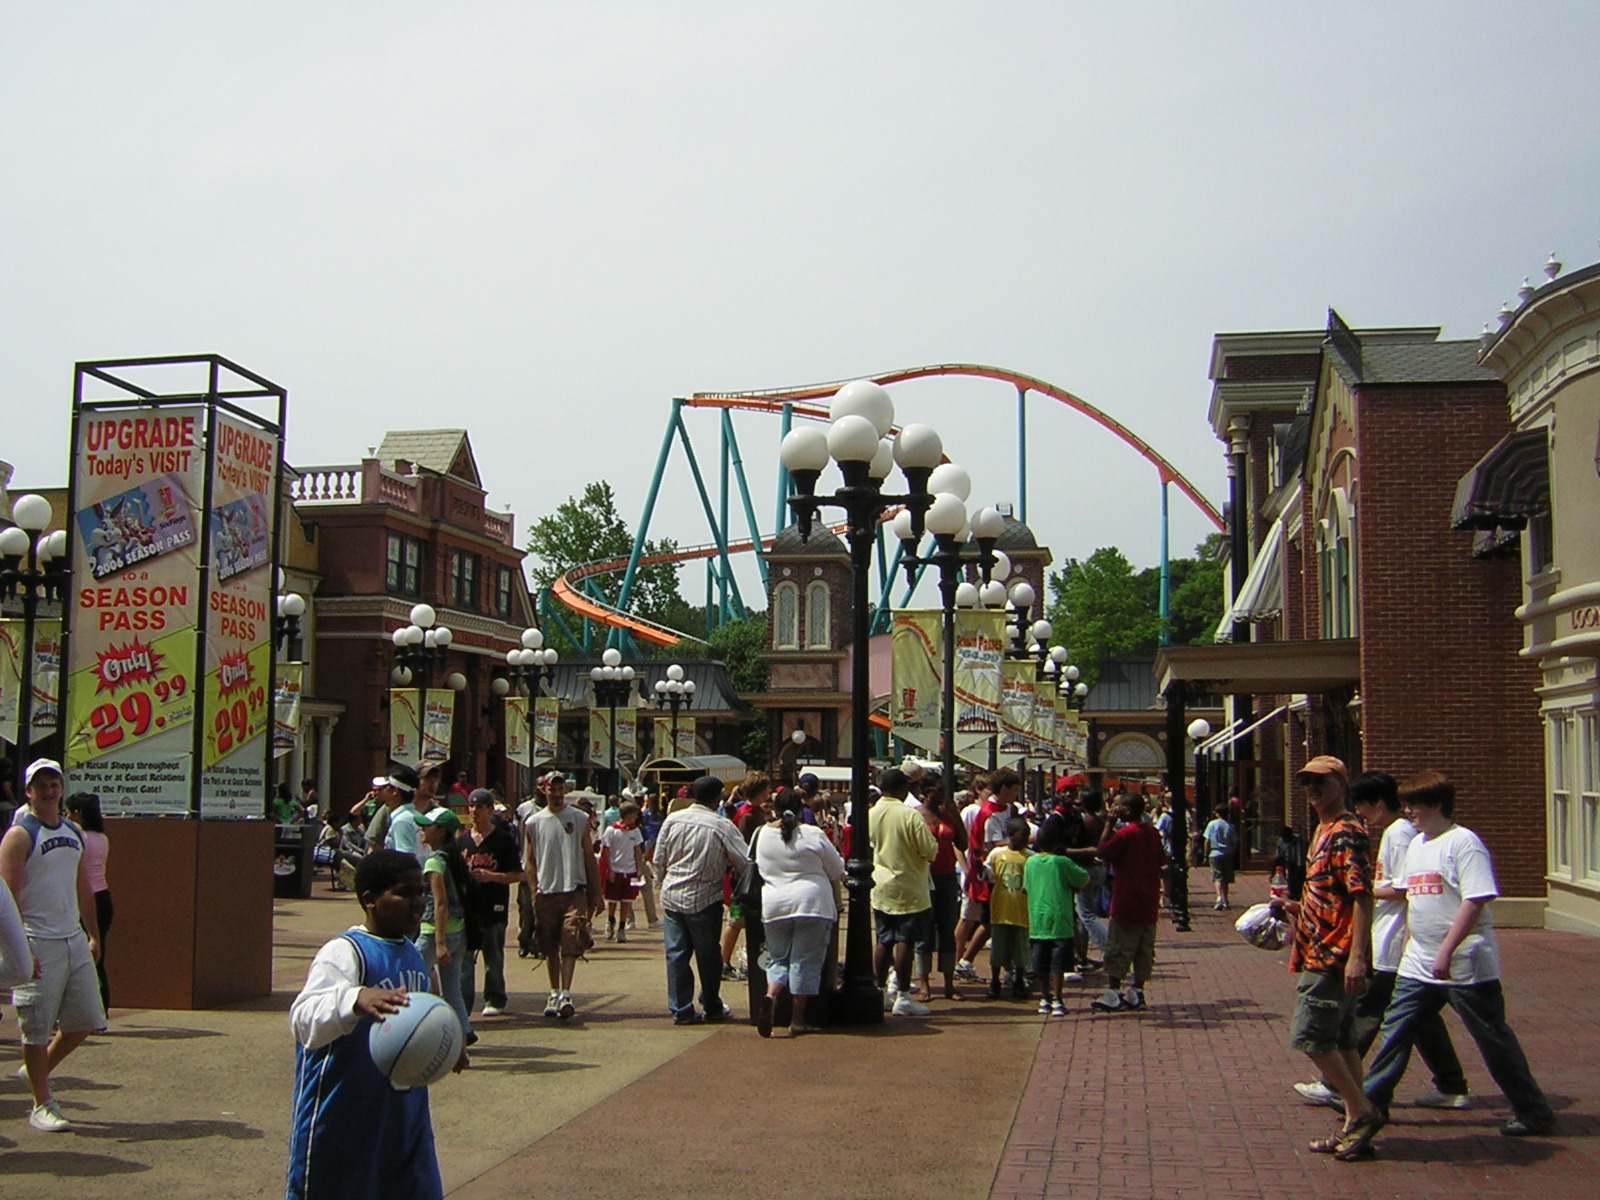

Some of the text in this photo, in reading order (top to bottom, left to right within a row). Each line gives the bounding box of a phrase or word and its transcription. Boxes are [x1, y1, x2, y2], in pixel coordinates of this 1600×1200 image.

[87, 416, 194, 451] UPGRADE
[218, 422, 272, 472] UPGRADE
[87, 450, 191, 480] Today's VISIT
[249, 469, 270, 495] VISIT
[97, 529, 191, 576] 2006 SEASON PASS
[121, 571, 148, 581] to a
[80, 586, 187, 608] SEASON
[210, 591, 265, 621] SEASON
[100, 610, 165, 631] PASS
[221, 617, 256, 642] PASS
[103, 650, 152, 682] Only
[223, 659, 248, 687] Only
[70, 773, 82, 781] the
[85, 773, 102, 781] Park
[125, 773, 147, 781] Guest
[150, 773, 185, 781] Relations
[86, 761, 108, 769] Retail
[111, 761, 135, 771] Shops
[137, 761, 180, 772] throughout
[93, 785, 162, 793] at the Front Gate!
